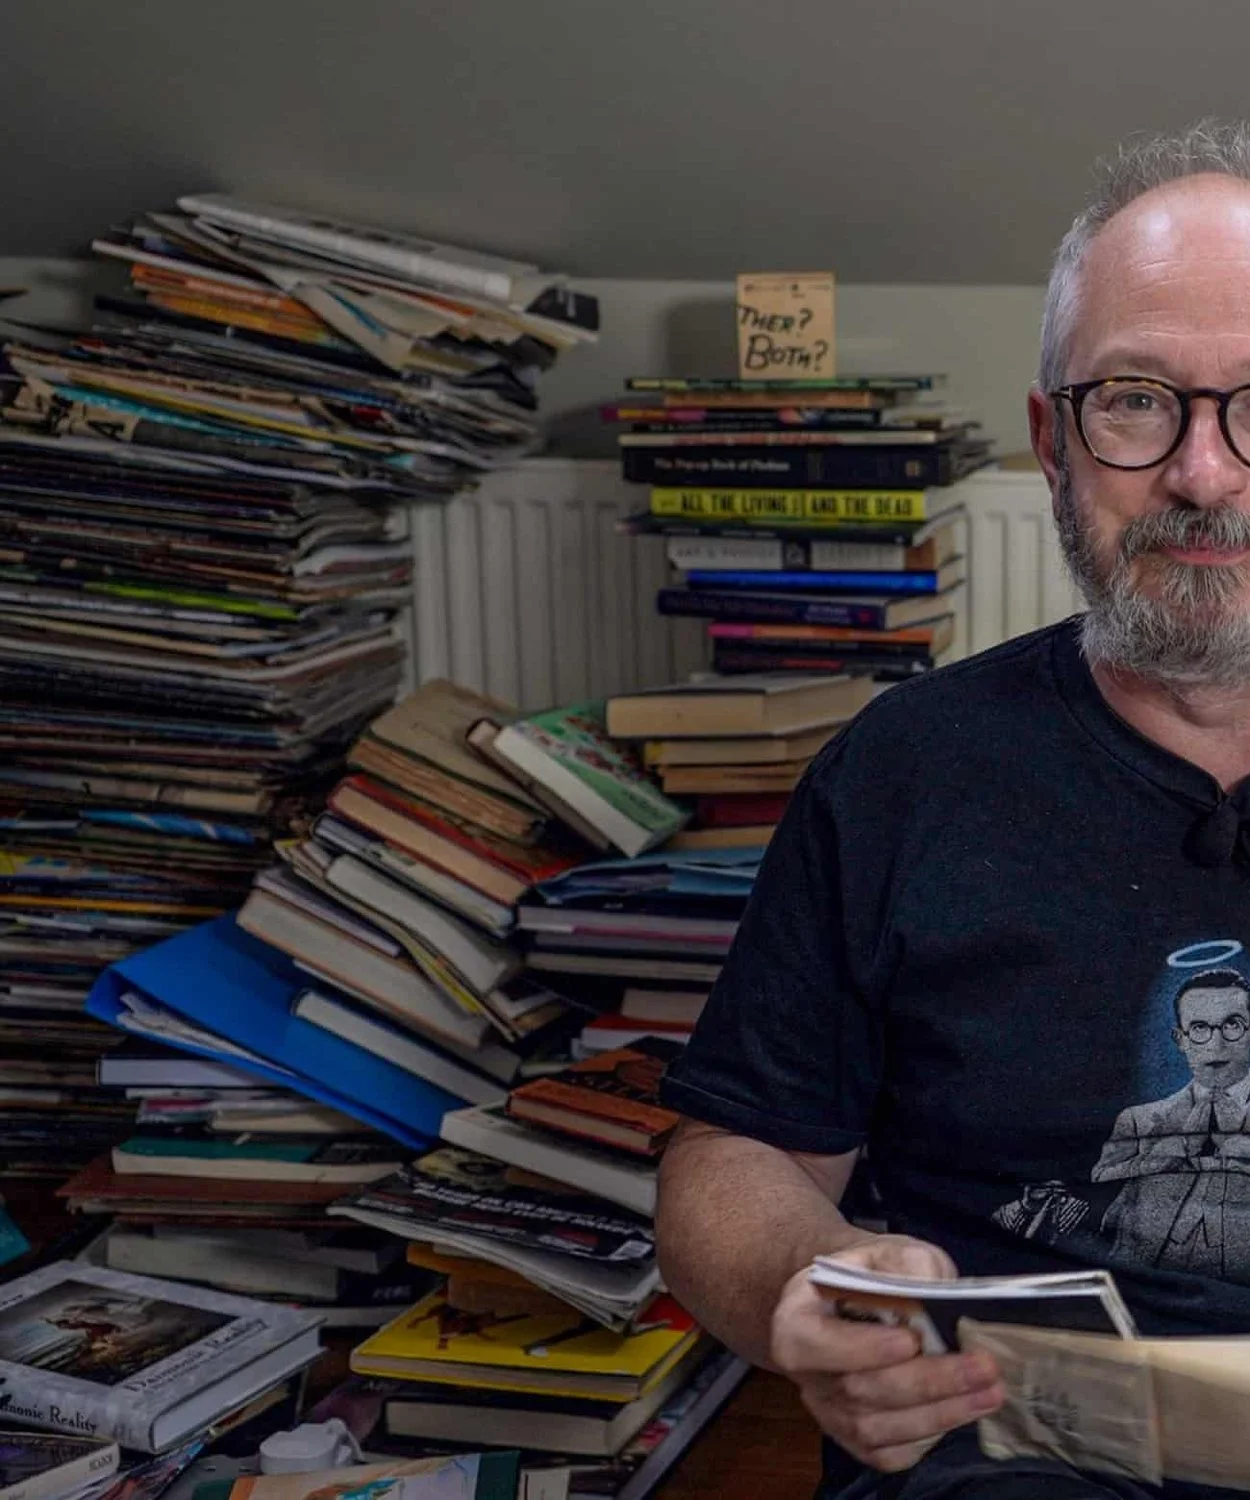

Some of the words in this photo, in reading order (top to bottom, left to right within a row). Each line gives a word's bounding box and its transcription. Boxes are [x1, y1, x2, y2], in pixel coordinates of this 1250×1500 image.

[681, 493, 703, 514] ALL
[712, 494, 736, 515] THE
[743, 495, 787, 515] LIVING
[811, 496, 837, 515] AND
[845, 496, 869, 516] THE
[875, 497, 913, 516] DEAD
[0, 1403, 45, 1421] monic
[49, 1405, 98, 1433] Reality
